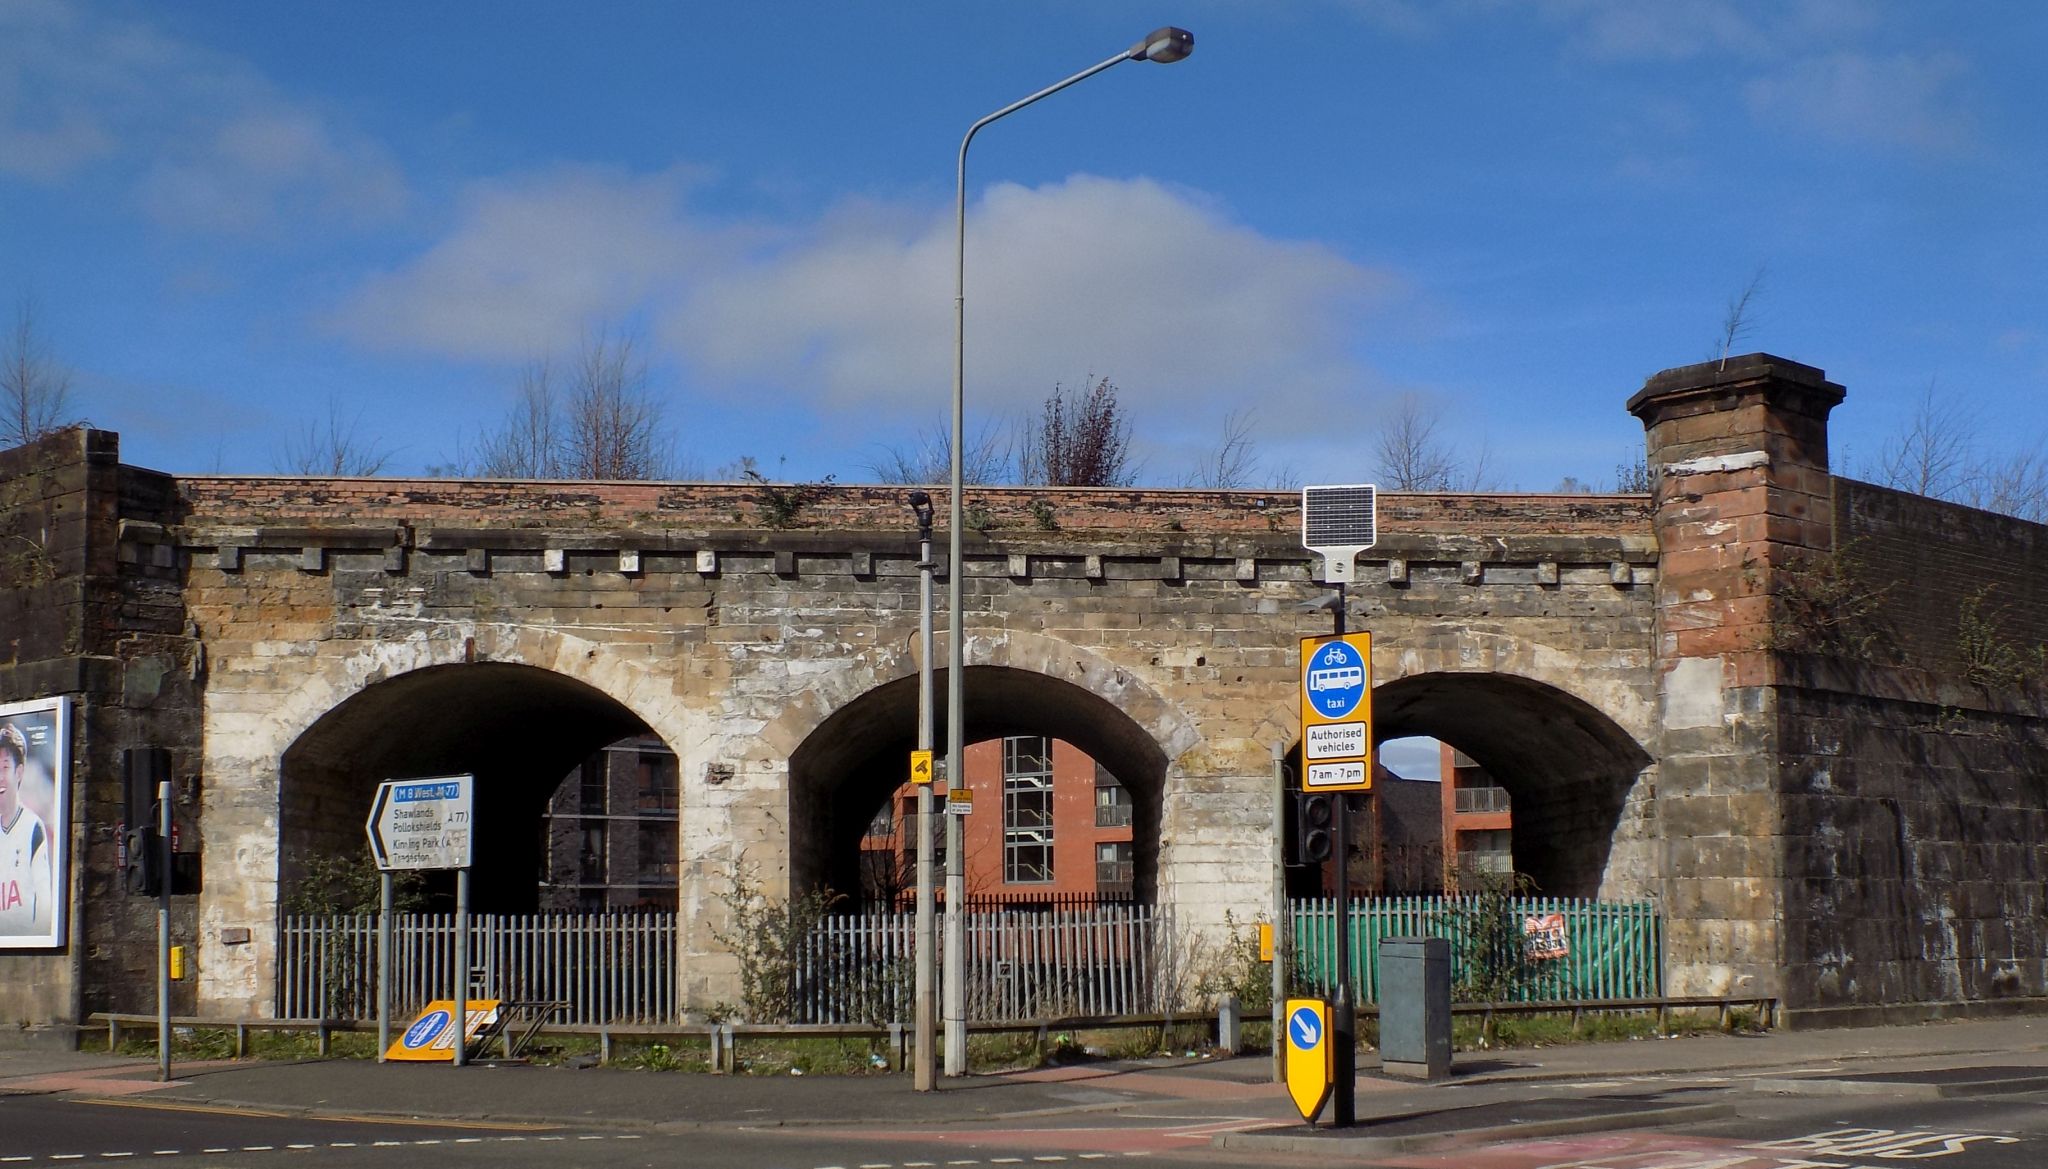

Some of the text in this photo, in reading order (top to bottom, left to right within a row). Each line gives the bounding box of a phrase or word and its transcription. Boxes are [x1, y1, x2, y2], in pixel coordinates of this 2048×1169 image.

[1327, 697, 1345, 709] taxi
[1311, 728, 1362, 740] Authorised
[1317, 742, 1355, 753] vehicles
[394, 808, 434, 820] Shawlands
[393, 822, 442, 833] Pollokshields
[422, 838, 440, 849] Park
[0, 880, 22, 911] IA
[1732, 1127, 2022, 1160] BUS
